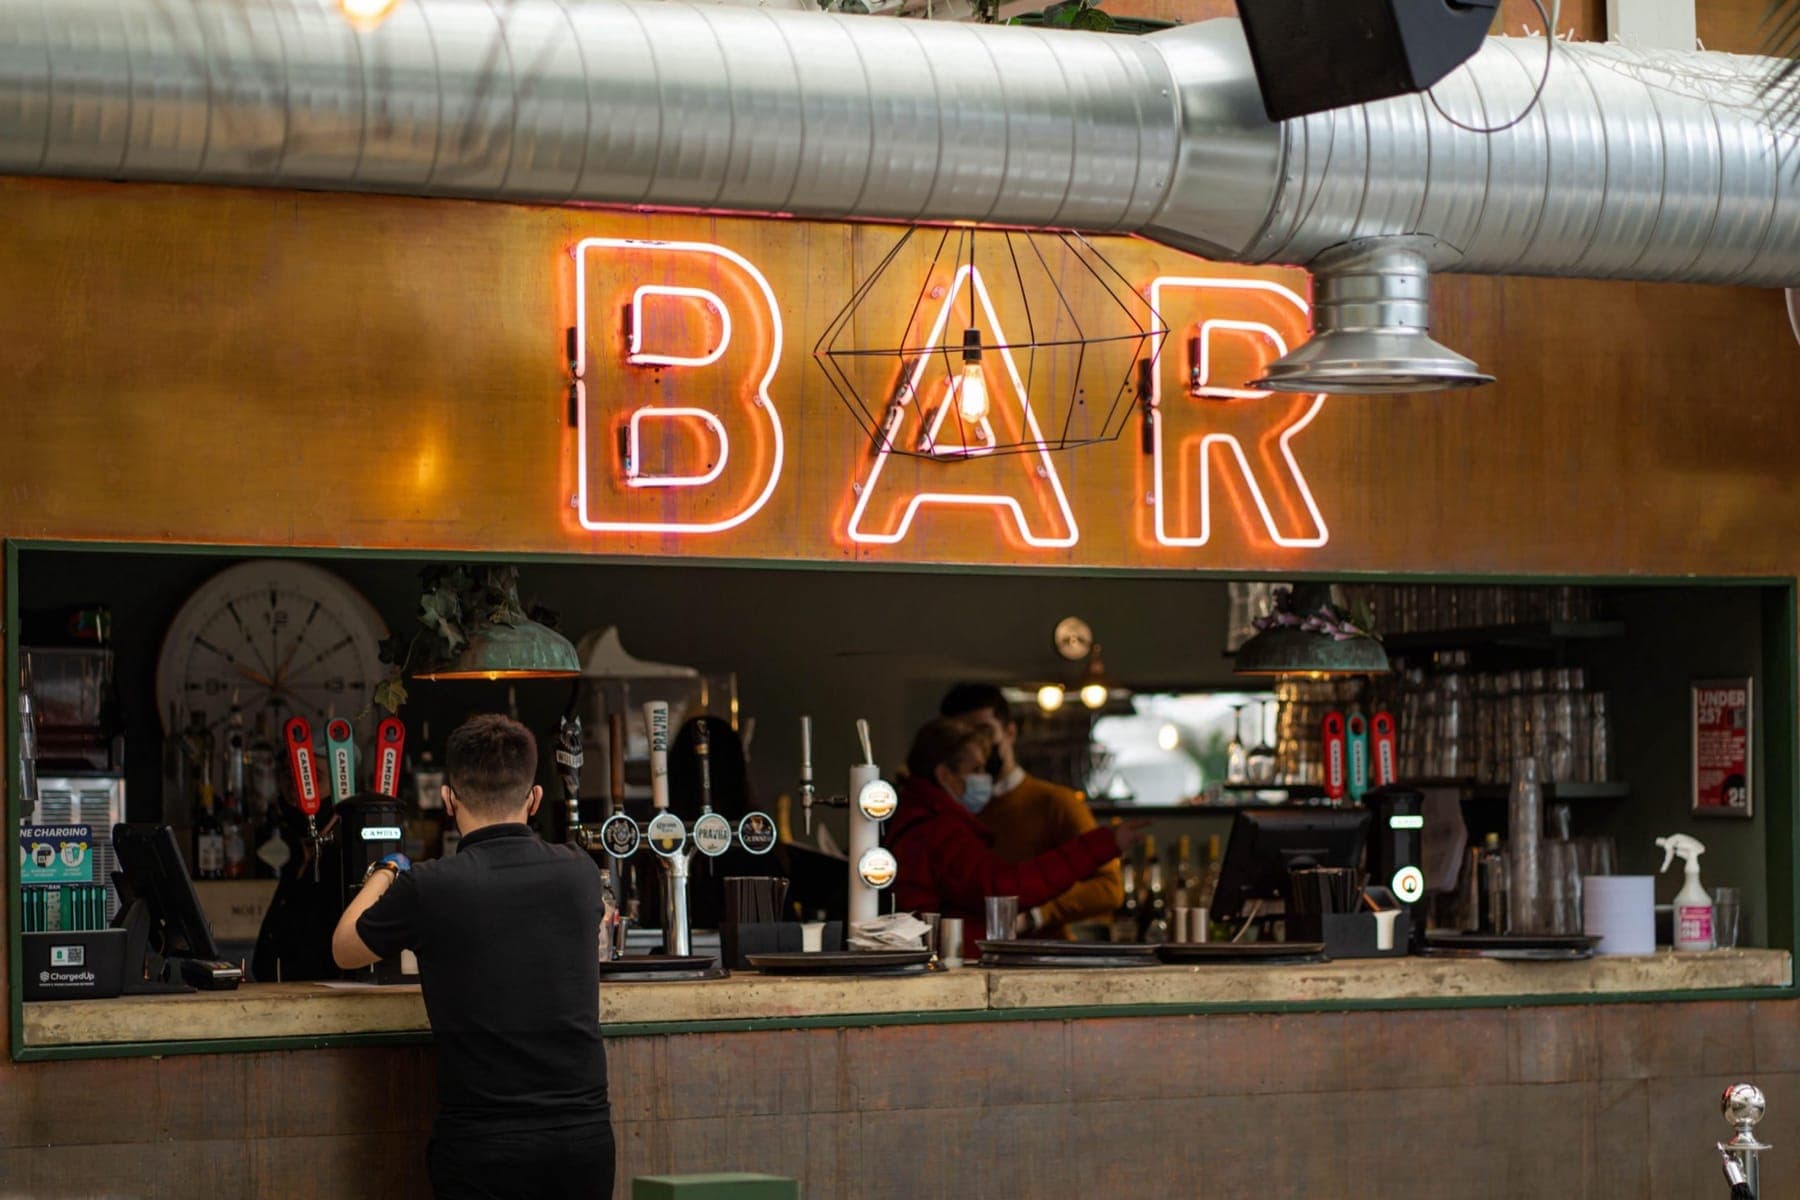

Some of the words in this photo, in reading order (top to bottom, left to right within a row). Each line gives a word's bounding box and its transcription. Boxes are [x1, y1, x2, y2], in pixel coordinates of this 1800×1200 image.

[575, 236, 1329, 549] BAR
[1699, 689, 1745, 707] UNDER
[653, 708, 668, 752] PRAVHA
[299, 752, 312, 795] CAMDEN
[338, 752, 348, 795] CAMDEN
[34, 827, 88, 837] CHARGING
[50, 971, 95, 982] ChargedUp
